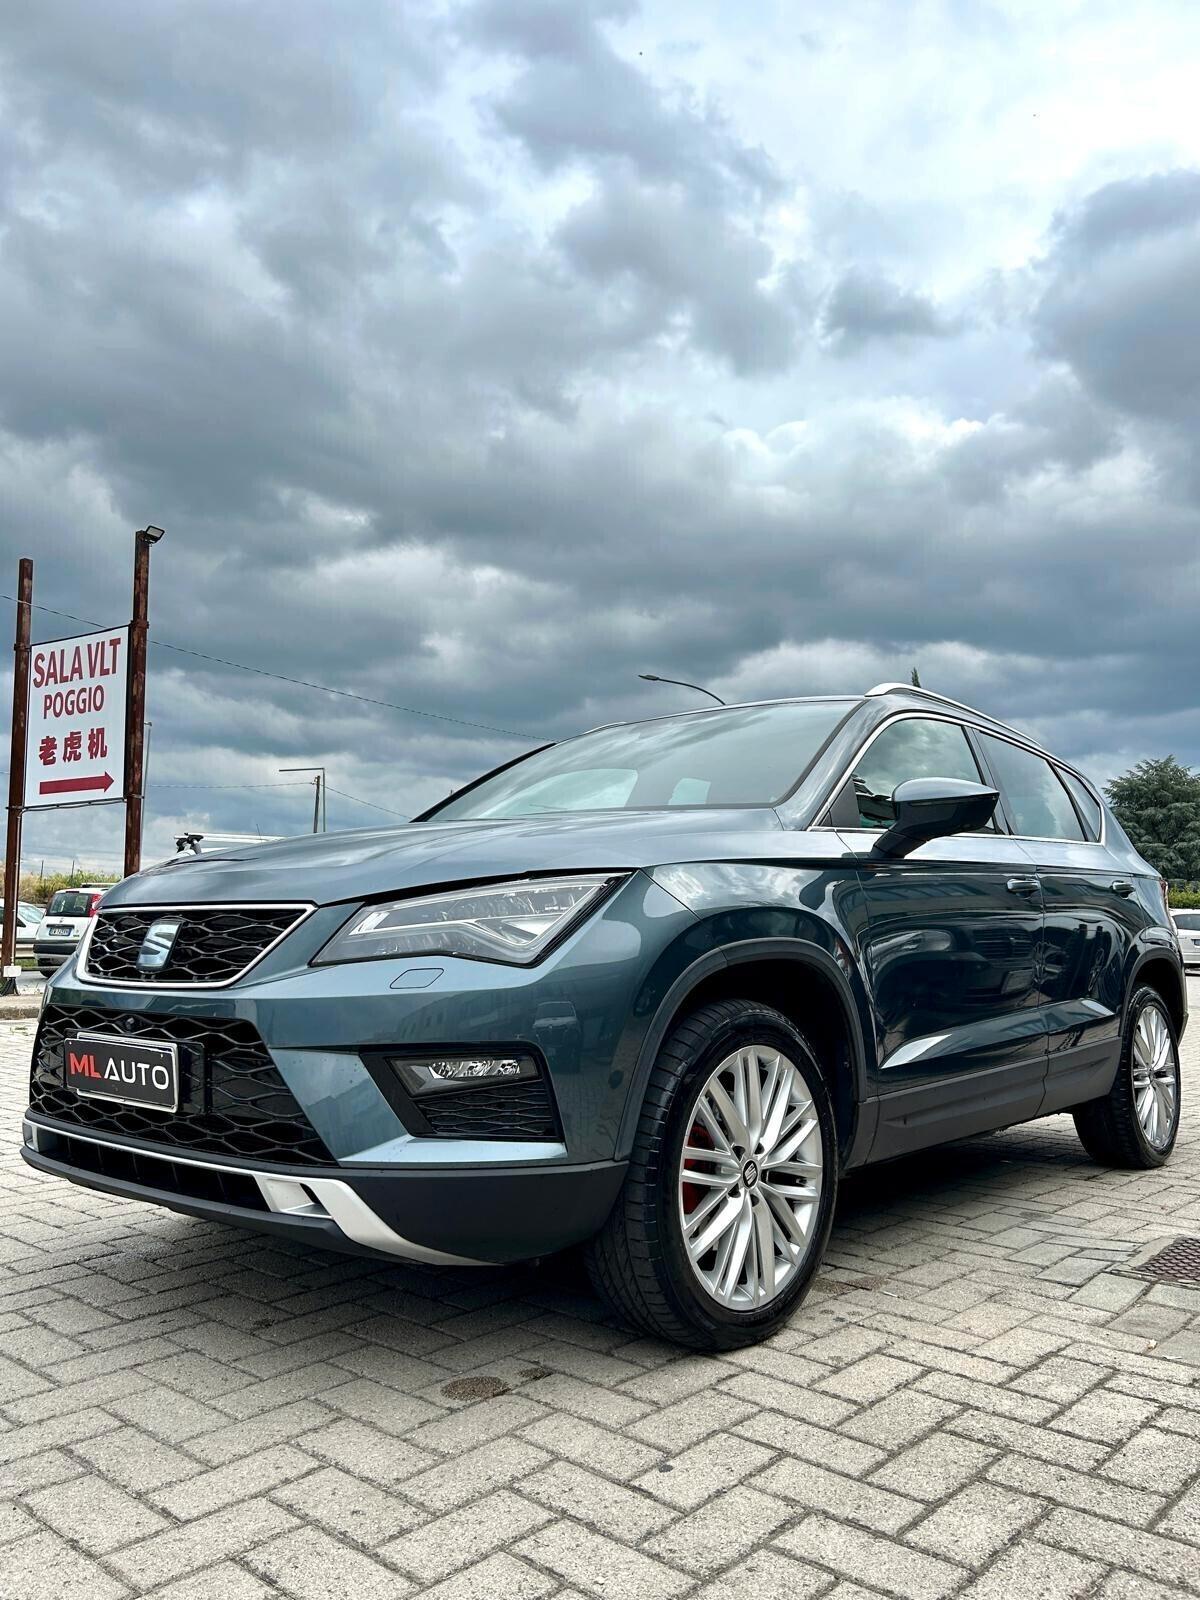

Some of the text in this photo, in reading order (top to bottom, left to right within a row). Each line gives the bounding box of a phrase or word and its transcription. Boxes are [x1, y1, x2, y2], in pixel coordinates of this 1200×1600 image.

[33, 637, 121, 688] SALA VLT
[43, 685, 105, 720] POGGIO
[38, 727, 108, 766] 老虎机
[69, 1053, 170, 1090] ML AUTO
